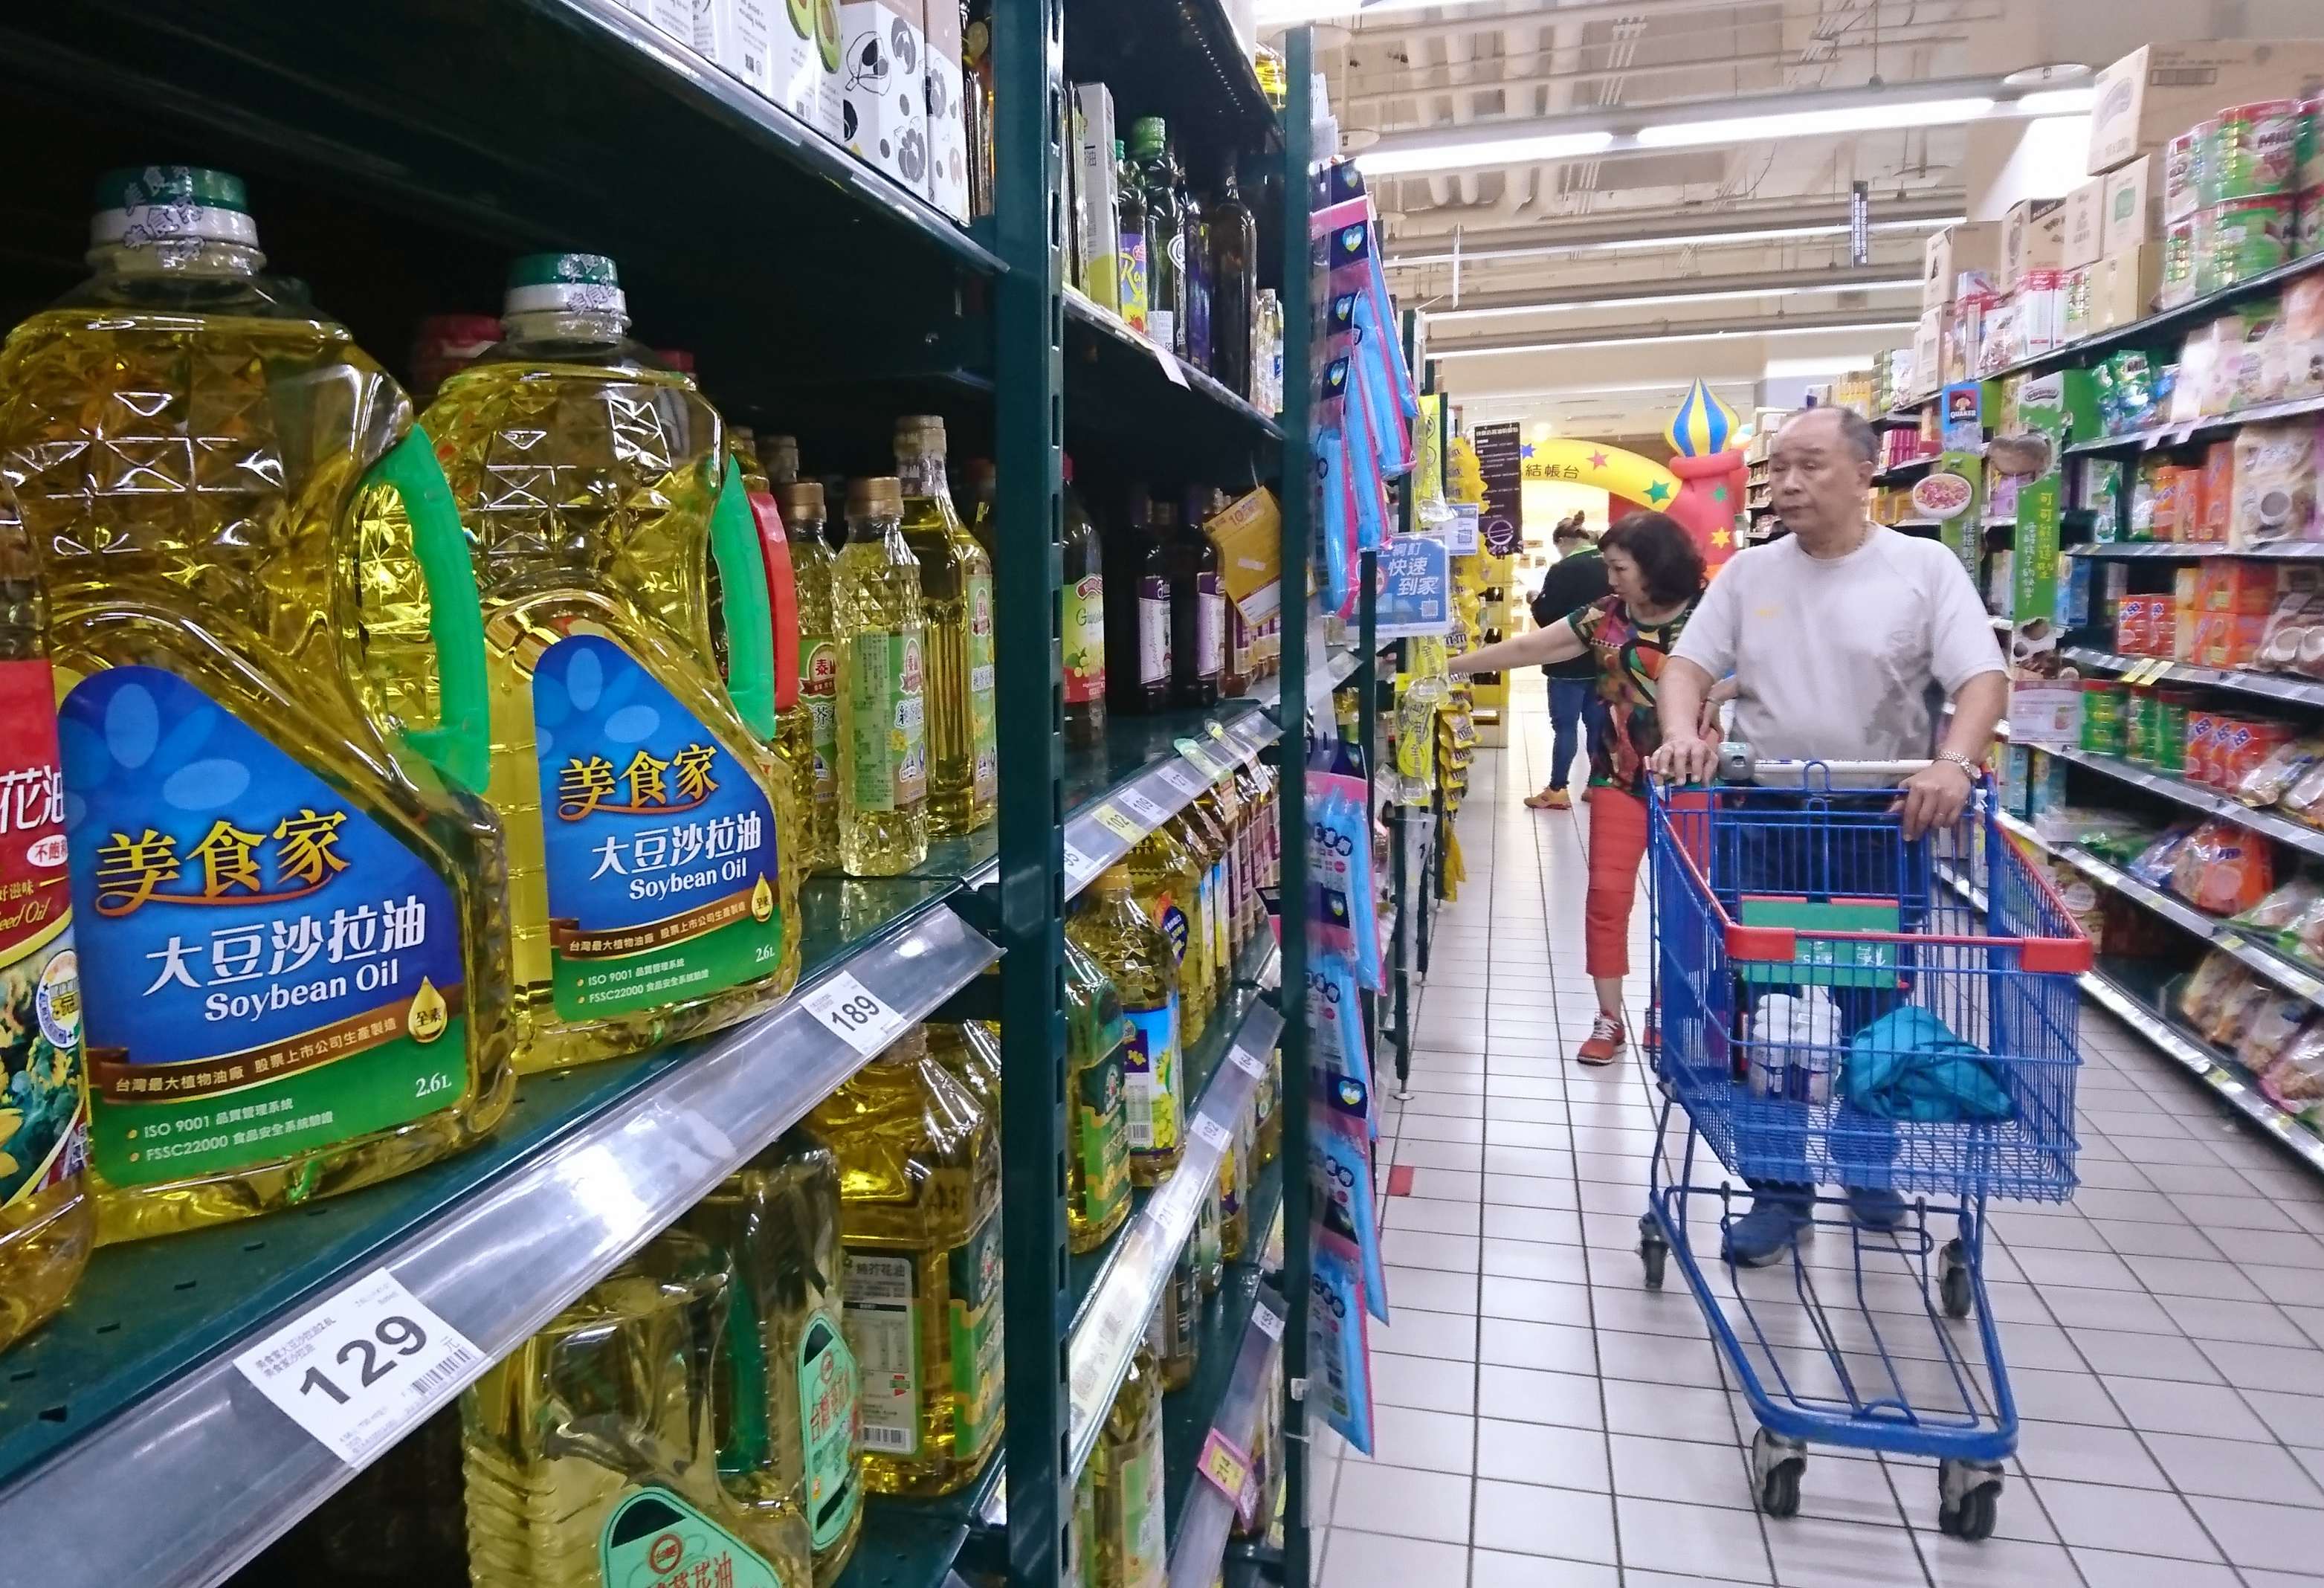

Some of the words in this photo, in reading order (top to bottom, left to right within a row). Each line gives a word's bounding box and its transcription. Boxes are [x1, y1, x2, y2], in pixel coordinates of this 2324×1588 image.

[1950, 410, 1977, 418] QUAKER
[1526, 463, 1580, 479] 結帳台
[1377, 543, 1422, 558] 上網訂
[1388, 557, 1428, 577] 快速
[1397, 576, 1439, 596] 到家
[558, 744, 720, 821] 美食家
[1169, 774, 1189, 787] 127
[1132, 798, 1153, 813] 109
[1106, 814, 1130, 831] 102
[590, 810, 761, 881] 大豆沙拉油
[97, 808, 351, 915] 美食家
[629, 868, 717, 901] Soybean
[722, 857, 747, 878] Oil
[0, 903, 24, 929] eed
[25, 897, 51, 924] Oil
[569, 937, 654, 952] 台灣最大植物油廠
[660, 901, 746, 939] 股票上市公司生產製造
[143, 894, 427, 997] 大豆沙拉油
[755, 946, 775, 963] 2.6L
[204, 975, 346, 1022] Soybean
[357, 959, 399, 993] Oil
[588, 975, 607, 987] ISO
[610, 969, 632, 983] 9001
[589, 984, 644, 1003] FSSC22000
[416, 1008, 442, 1027] 全素
[831, 995, 880, 1031] 189
[116, 1065, 244, 1093] 台灣最大植物油廠
[254, 1017, 397, 1073] 股票上市公司生產製造
[416, 1073, 452, 1099] 2.6L
[144, 1122, 170, 1138] ISO
[175, 1117, 210, 1134] 9001
[216, 1097, 294, 1125] 品質管理系統
[1201, 1120, 1221, 1140] 192
[146, 1135, 228, 1162] FSSC22000
[299, 1315, 427, 1404] 129
